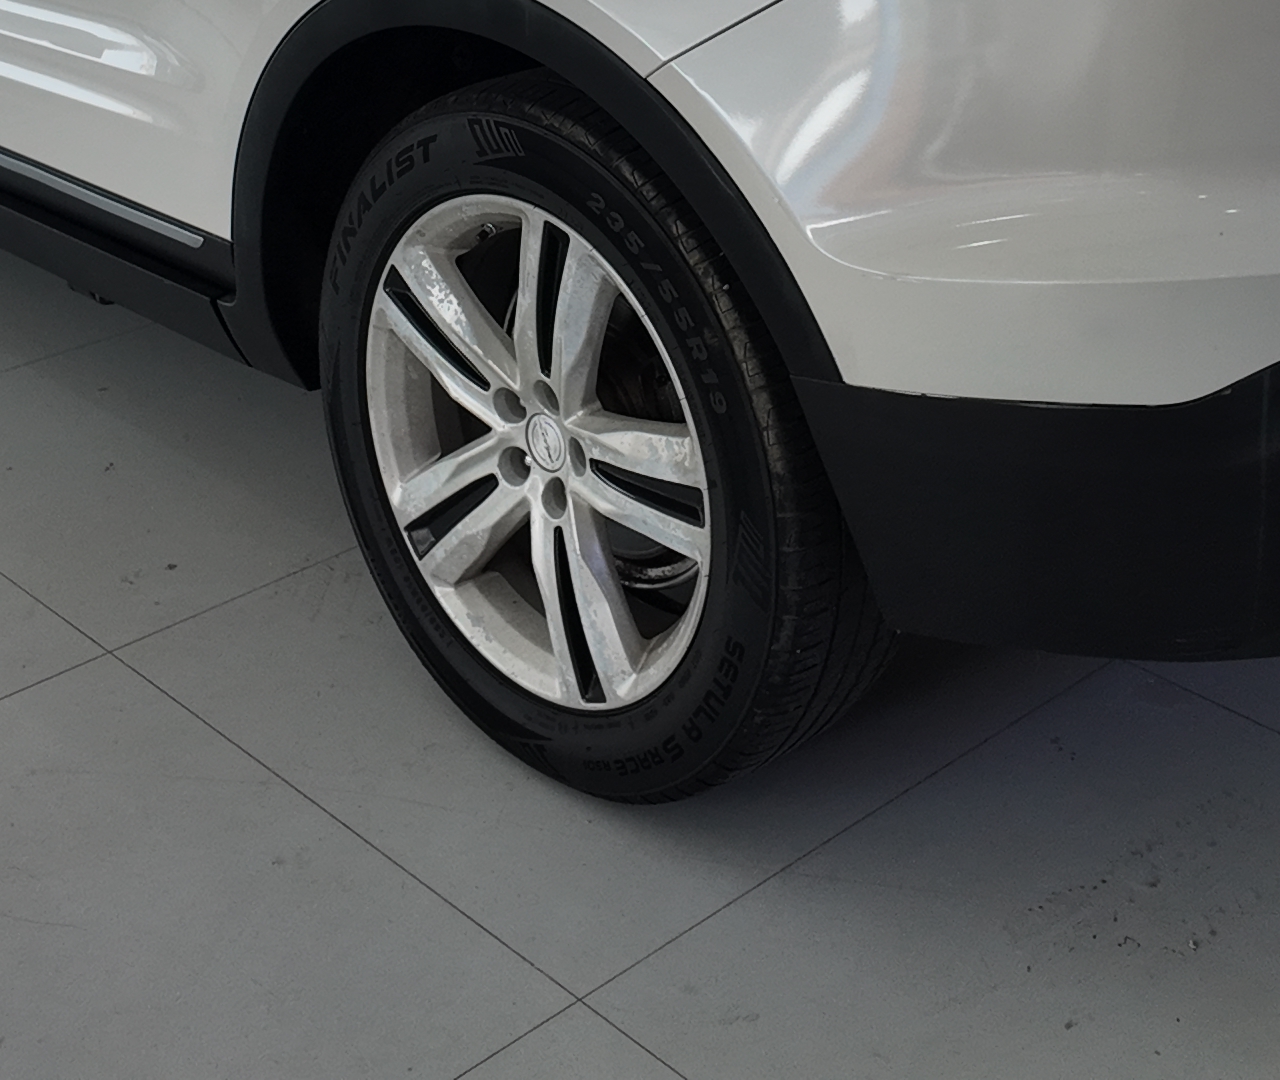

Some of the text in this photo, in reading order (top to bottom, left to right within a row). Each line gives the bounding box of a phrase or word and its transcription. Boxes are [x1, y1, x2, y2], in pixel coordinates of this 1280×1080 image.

[327, 134, 439, 296] FINALIST
[584, 191, 728, 417] 235/55R19
[681, 634, 746, 744] SETULA
